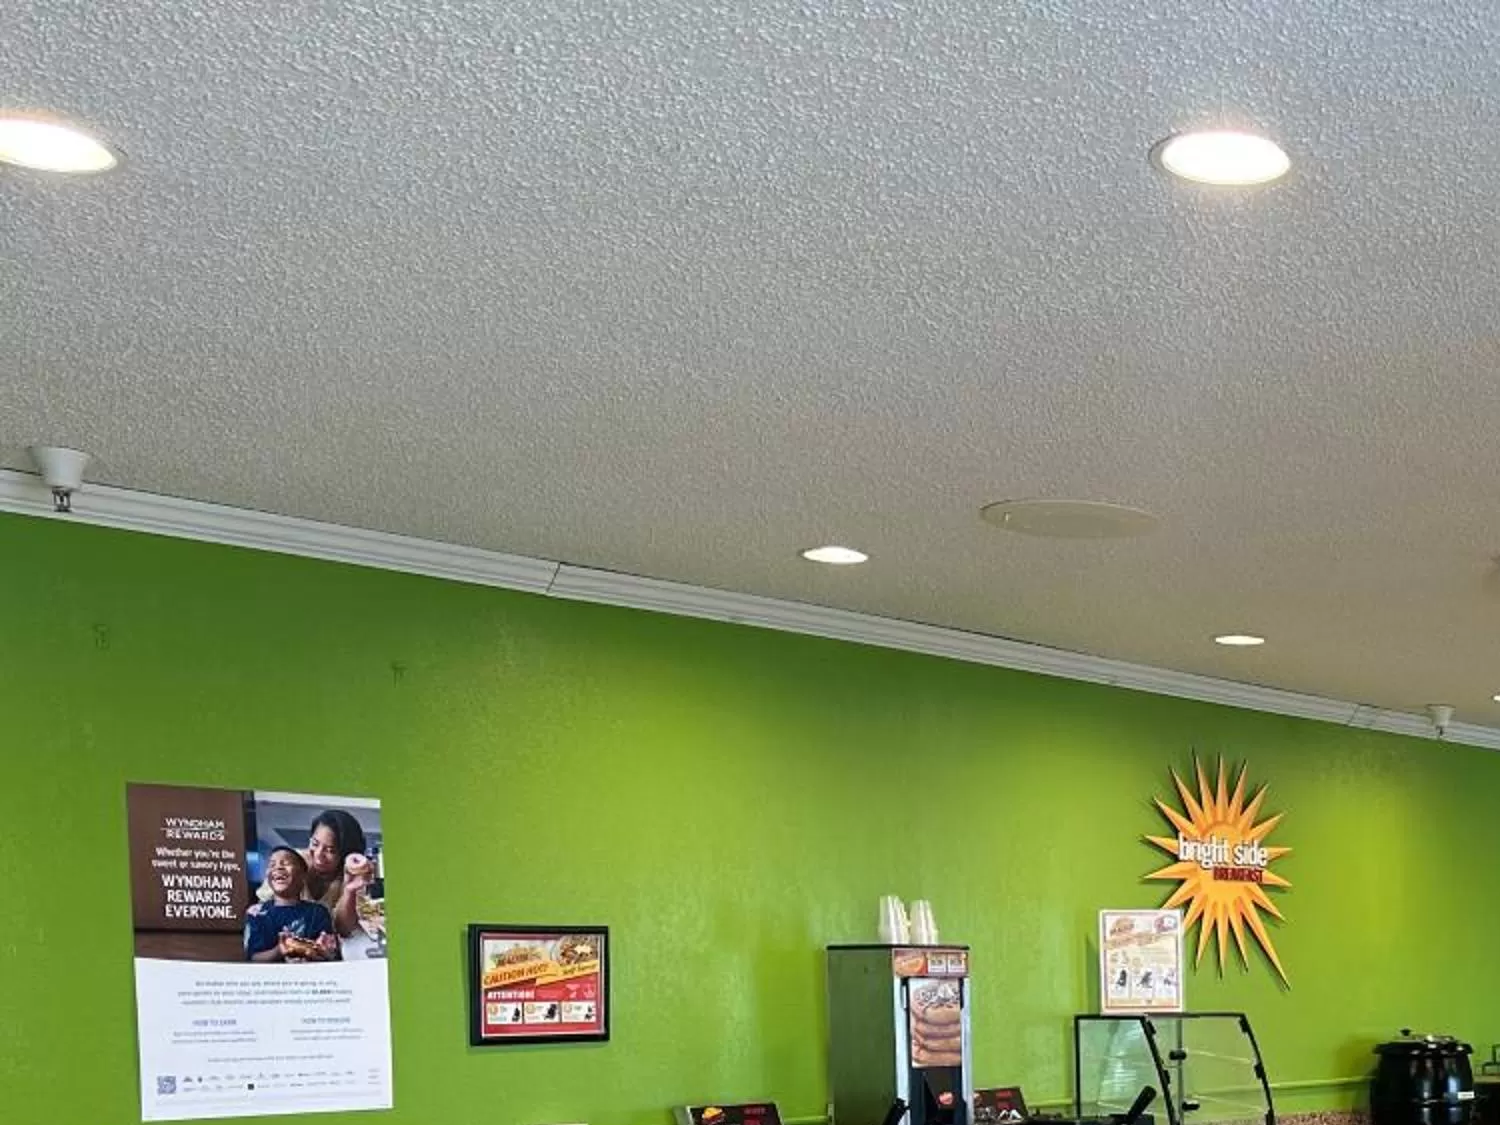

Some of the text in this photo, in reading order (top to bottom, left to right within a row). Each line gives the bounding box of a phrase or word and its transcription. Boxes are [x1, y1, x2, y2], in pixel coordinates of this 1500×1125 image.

[165, 818, 225, 828] WYNDHAM
[165, 830, 225, 840] REWARDS
[1178, 831, 1268, 868] bright side
[161, 873, 233, 889] WYNDHAM
[167, 889, 231, 904] REWARDS
[165, 904, 237, 919] EVERYONE.
